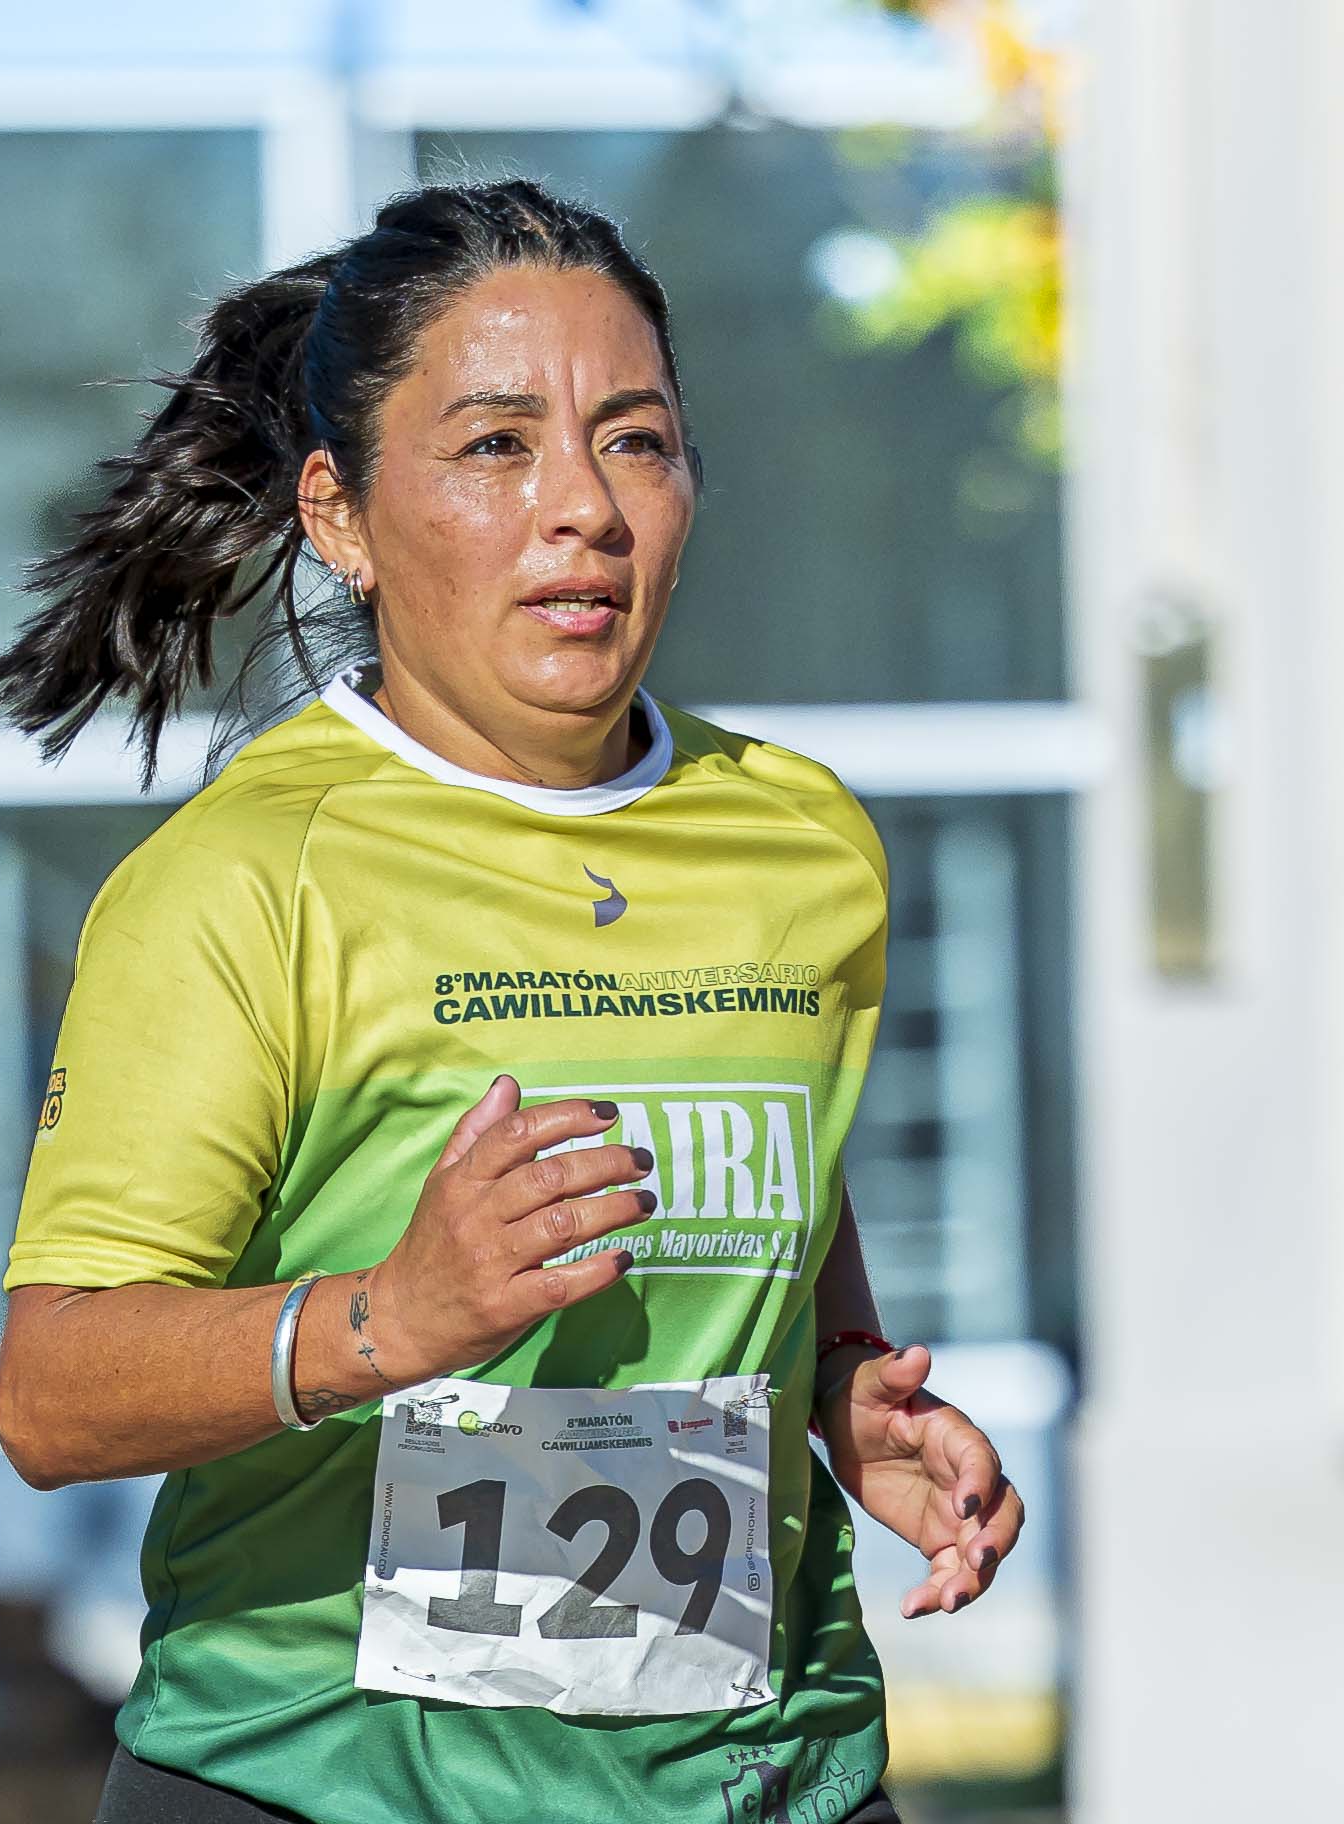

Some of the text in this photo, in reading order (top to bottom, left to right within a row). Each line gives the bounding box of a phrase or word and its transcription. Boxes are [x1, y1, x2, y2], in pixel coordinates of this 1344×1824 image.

[433, 987, 820, 1024] CAWILLIAMSKEMMIS
[656, 1227, 765, 1262] Mayoristas
[541, 1437, 653, 1451] CAWILLIAMSKEMMIS
[427, 1478, 732, 1640] 129
